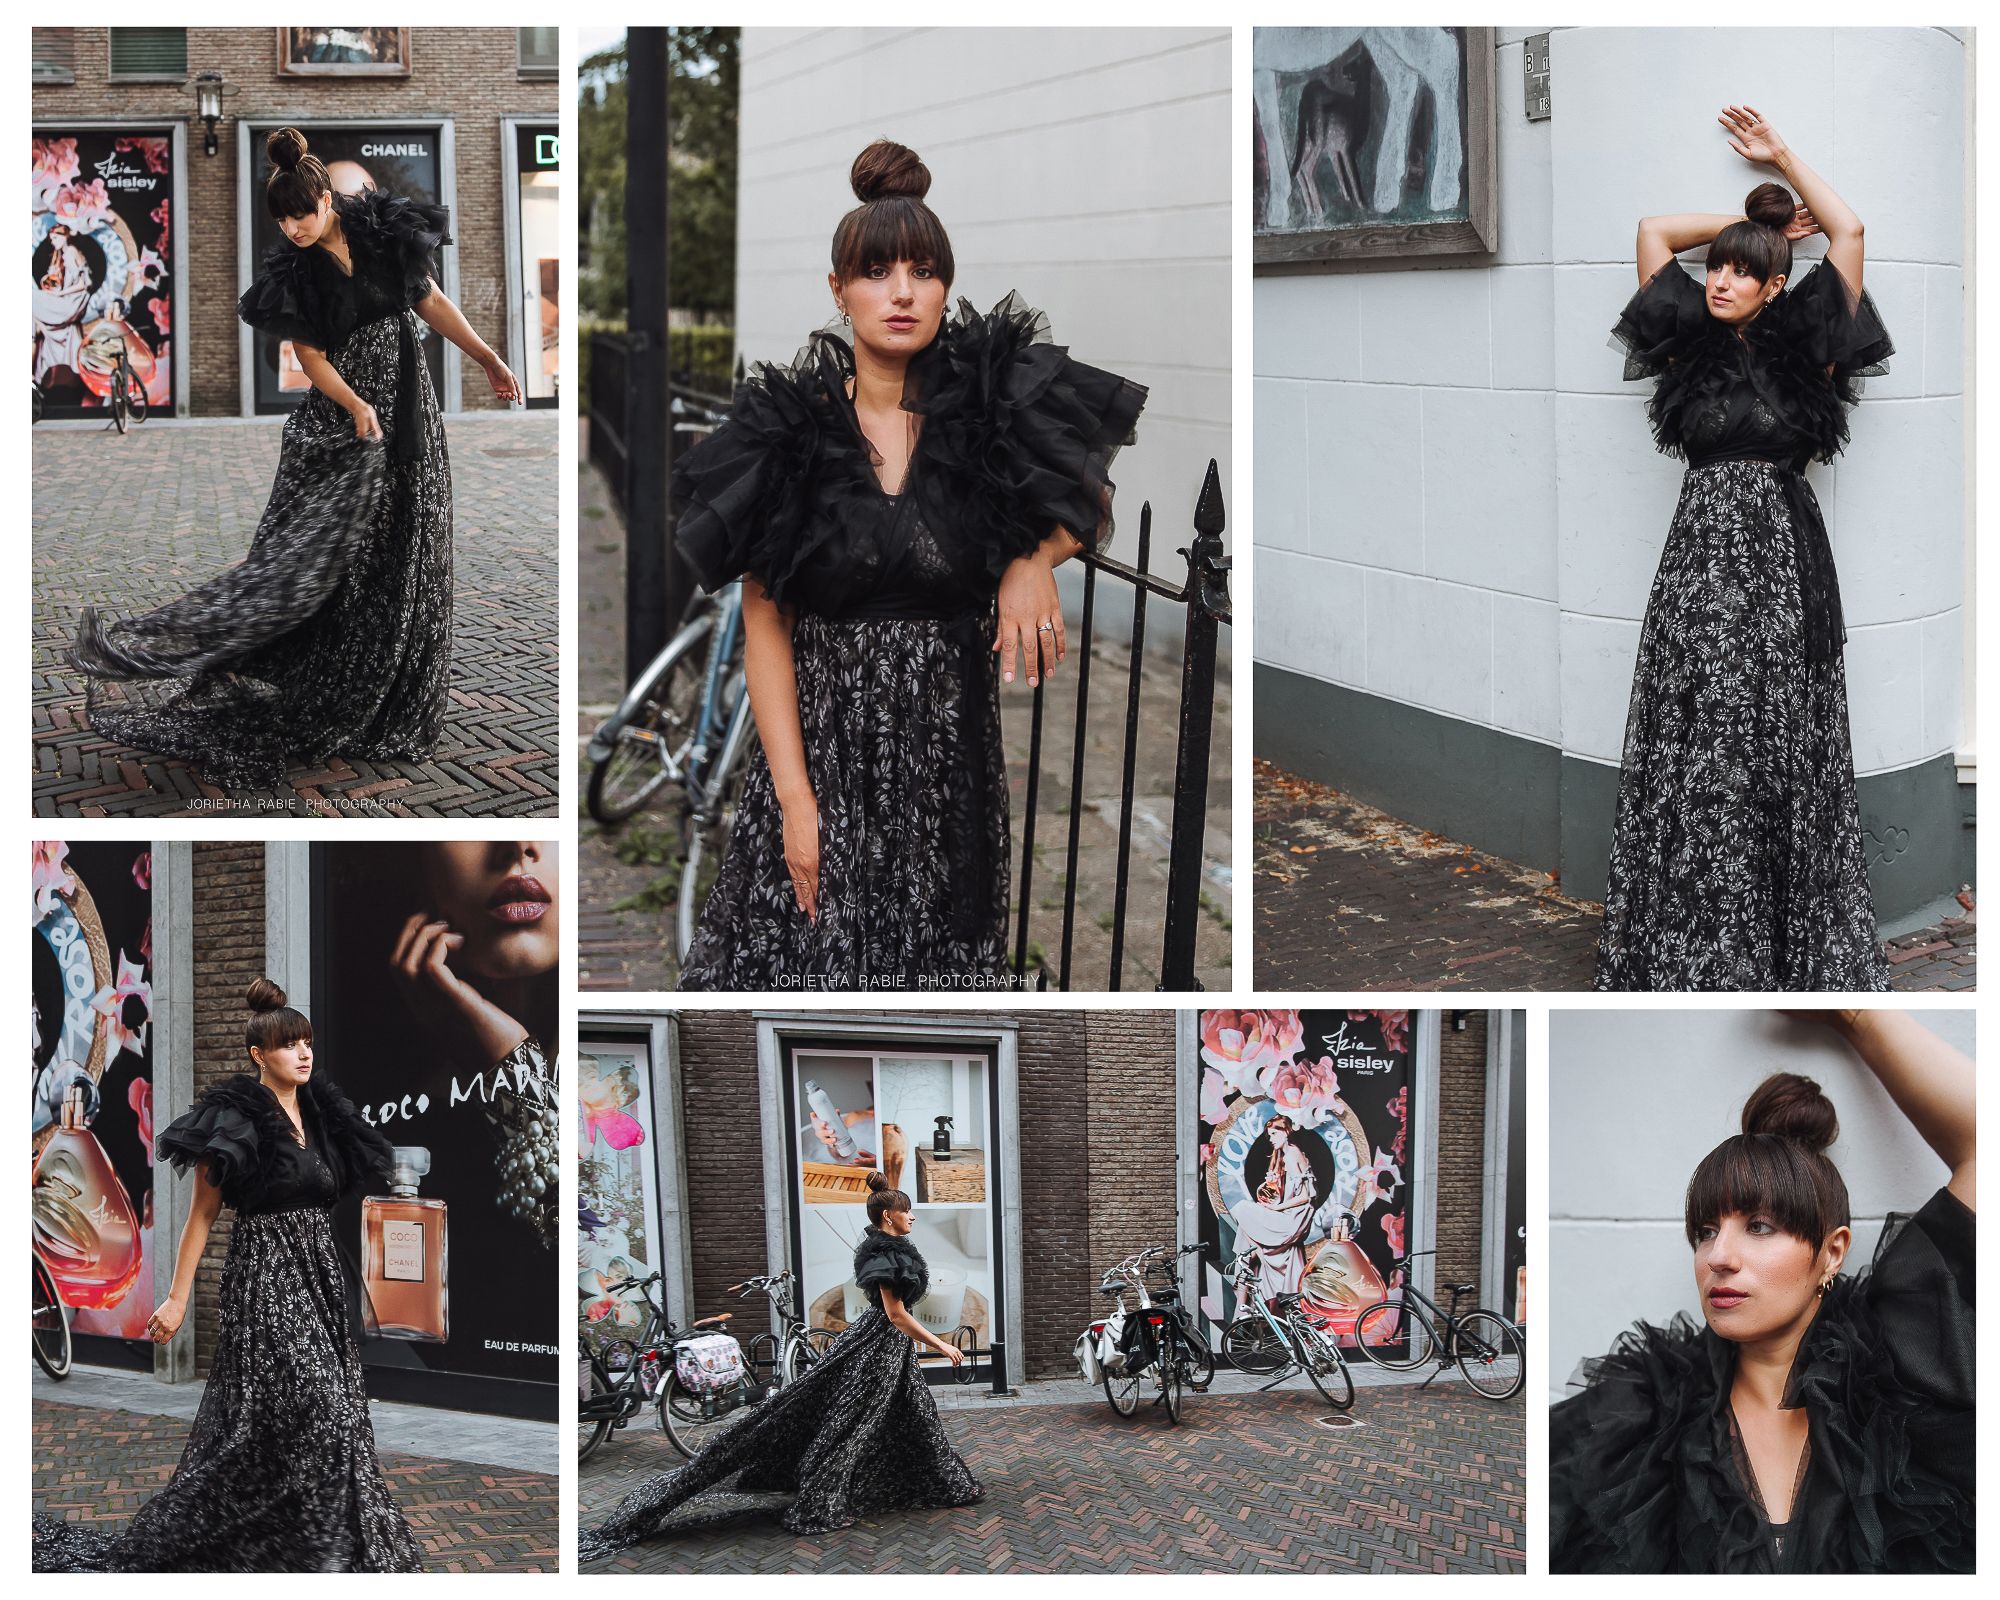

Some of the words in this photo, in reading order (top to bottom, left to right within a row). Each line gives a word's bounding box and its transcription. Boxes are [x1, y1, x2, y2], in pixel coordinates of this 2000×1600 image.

[361, 143, 428, 157] CHANEL
[107, 176, 157, 190] sisley
[1337, 1055, 1395, 1074] sisley
[390, 1232, 418, 1242] COCO
[484, 1339, 504, 1351] EAU
[505, 1341, 520, 1352] DE
